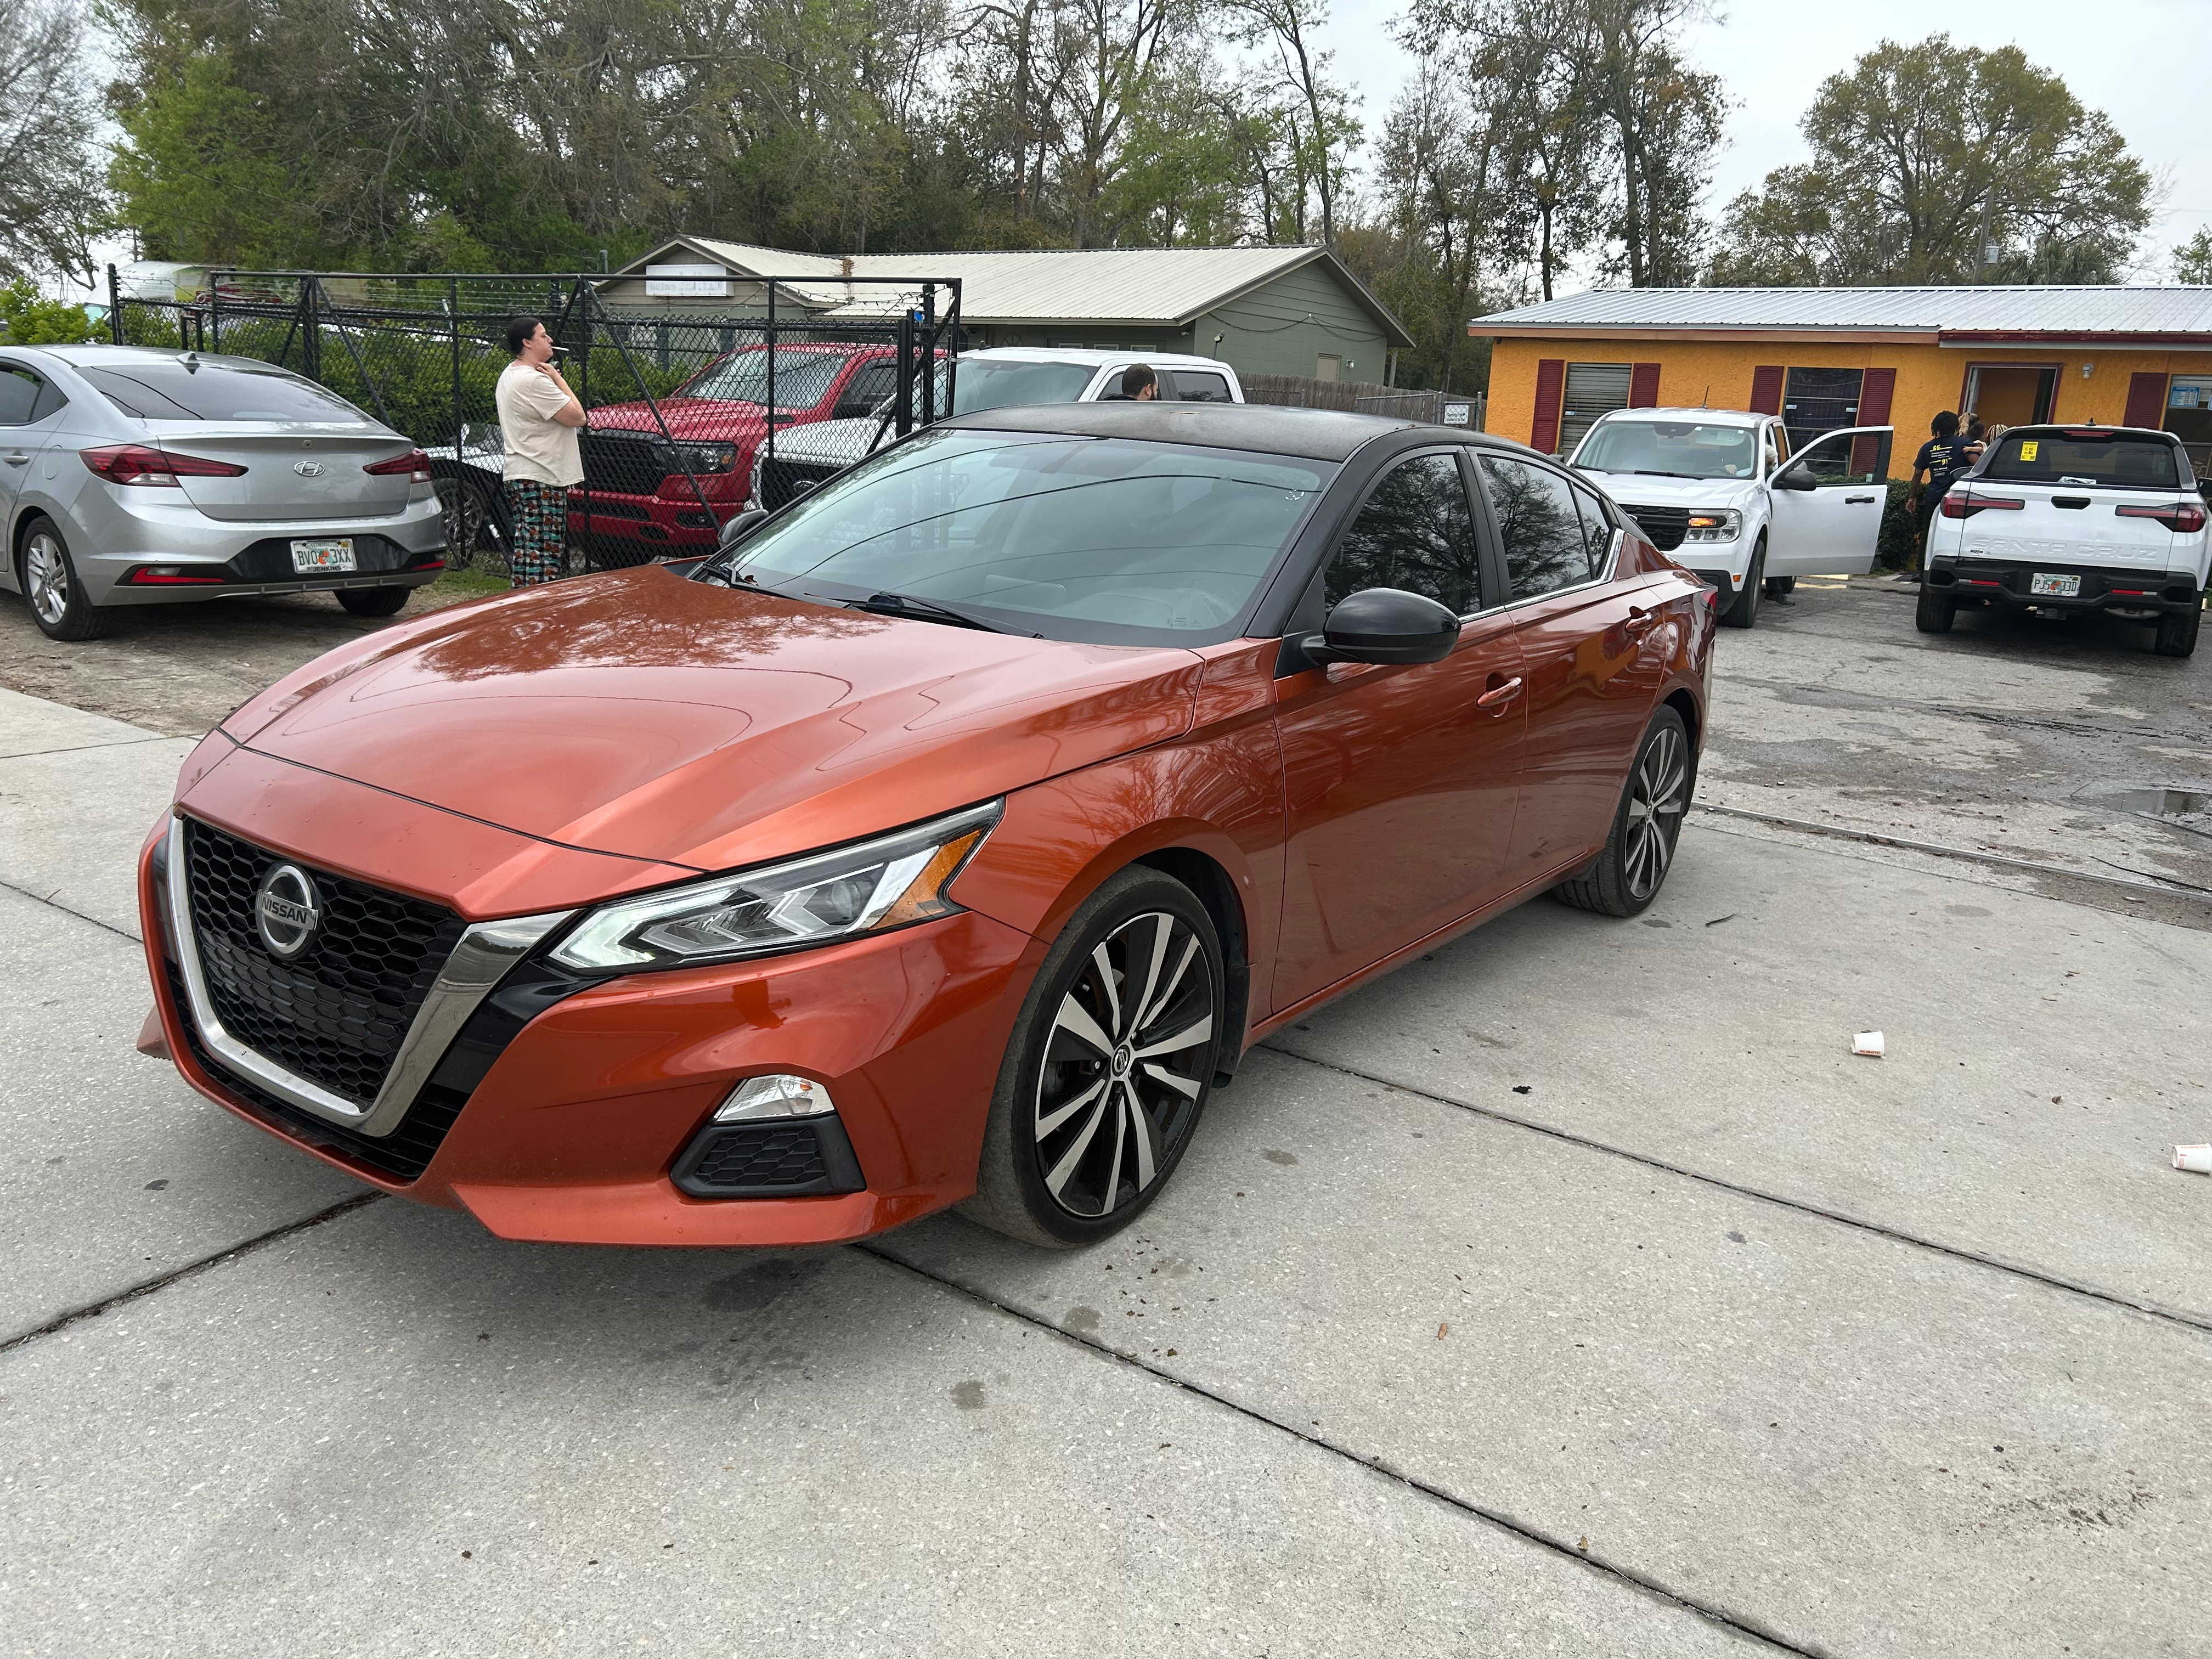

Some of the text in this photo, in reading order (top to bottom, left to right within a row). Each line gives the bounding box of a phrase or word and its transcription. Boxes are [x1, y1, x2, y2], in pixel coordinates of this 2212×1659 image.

[1972, 537, 2158, 560] SANTA CRUZ
[262, 896, 307, 924] NISSAN
